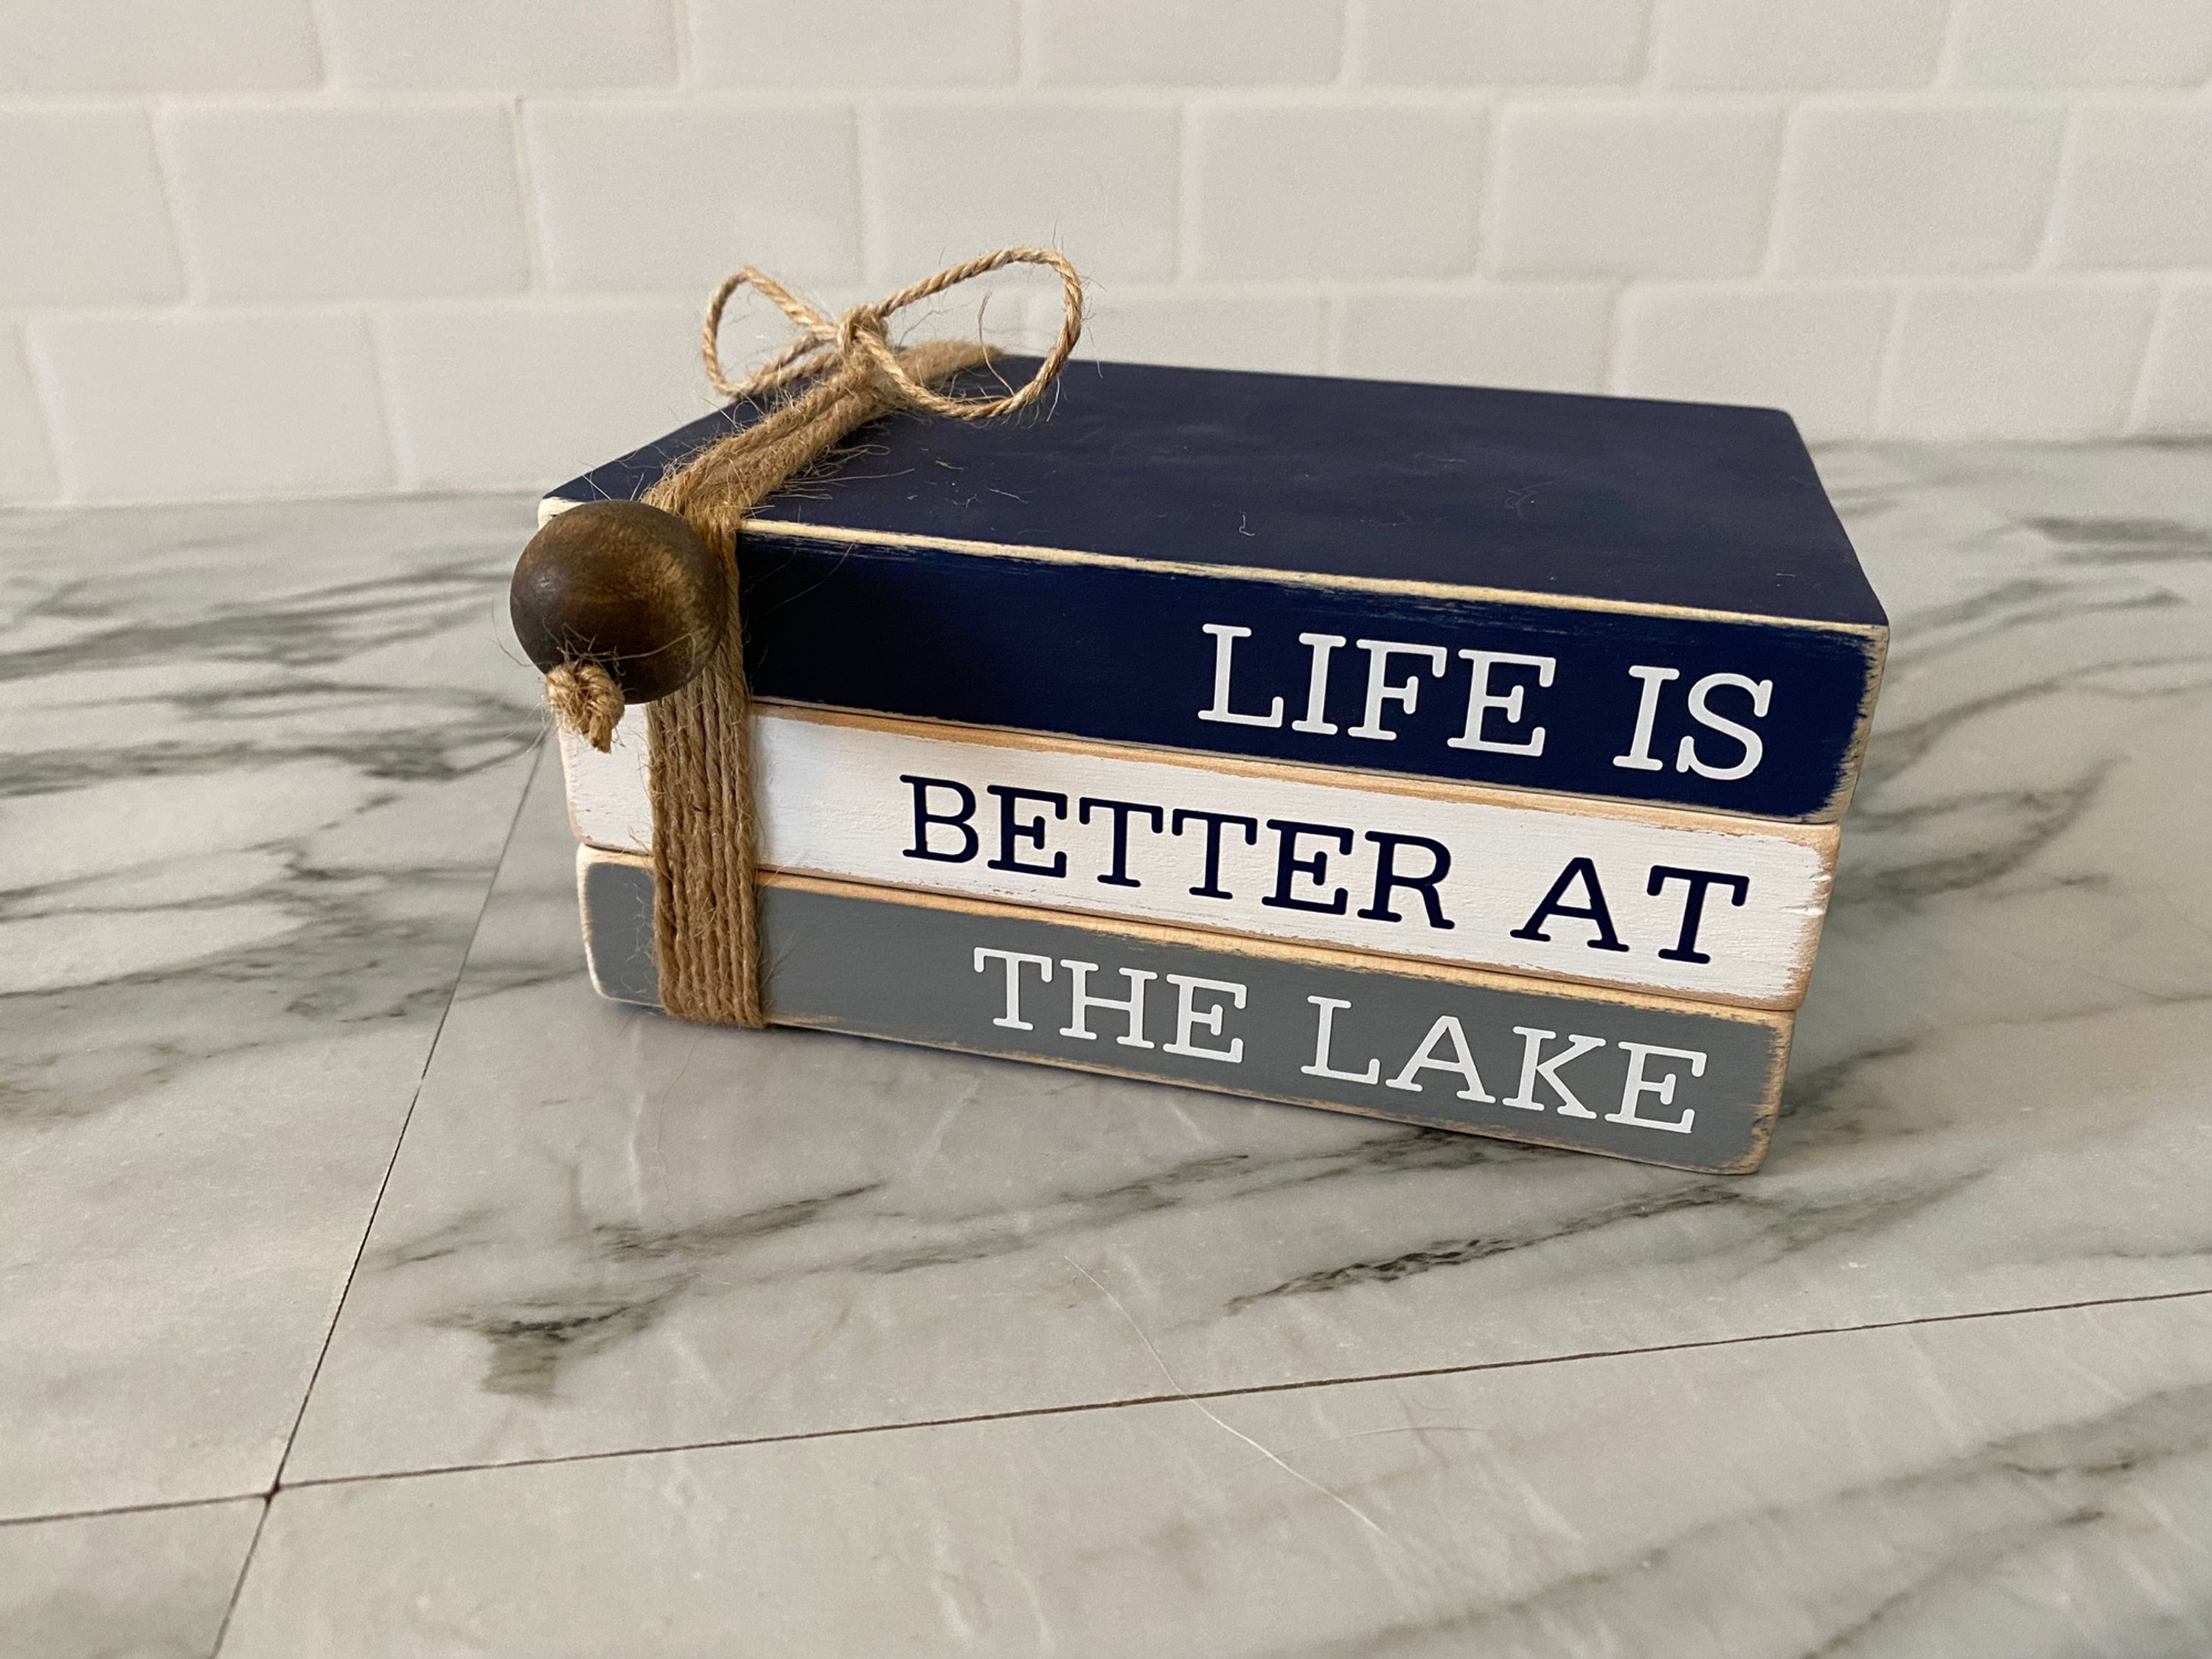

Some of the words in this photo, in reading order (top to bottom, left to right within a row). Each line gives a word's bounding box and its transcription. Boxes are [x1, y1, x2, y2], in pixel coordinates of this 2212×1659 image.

[1197, 623, 1557, 757] LIFE
[1613, 665, 1773, 780] IS
[900, 775, 1455, 930] BETTER
[1510, 857, 1750, 964] AT
[973, 947, 1248, 1064] THE
[1301, 995, 1708, 1134] LAKE
